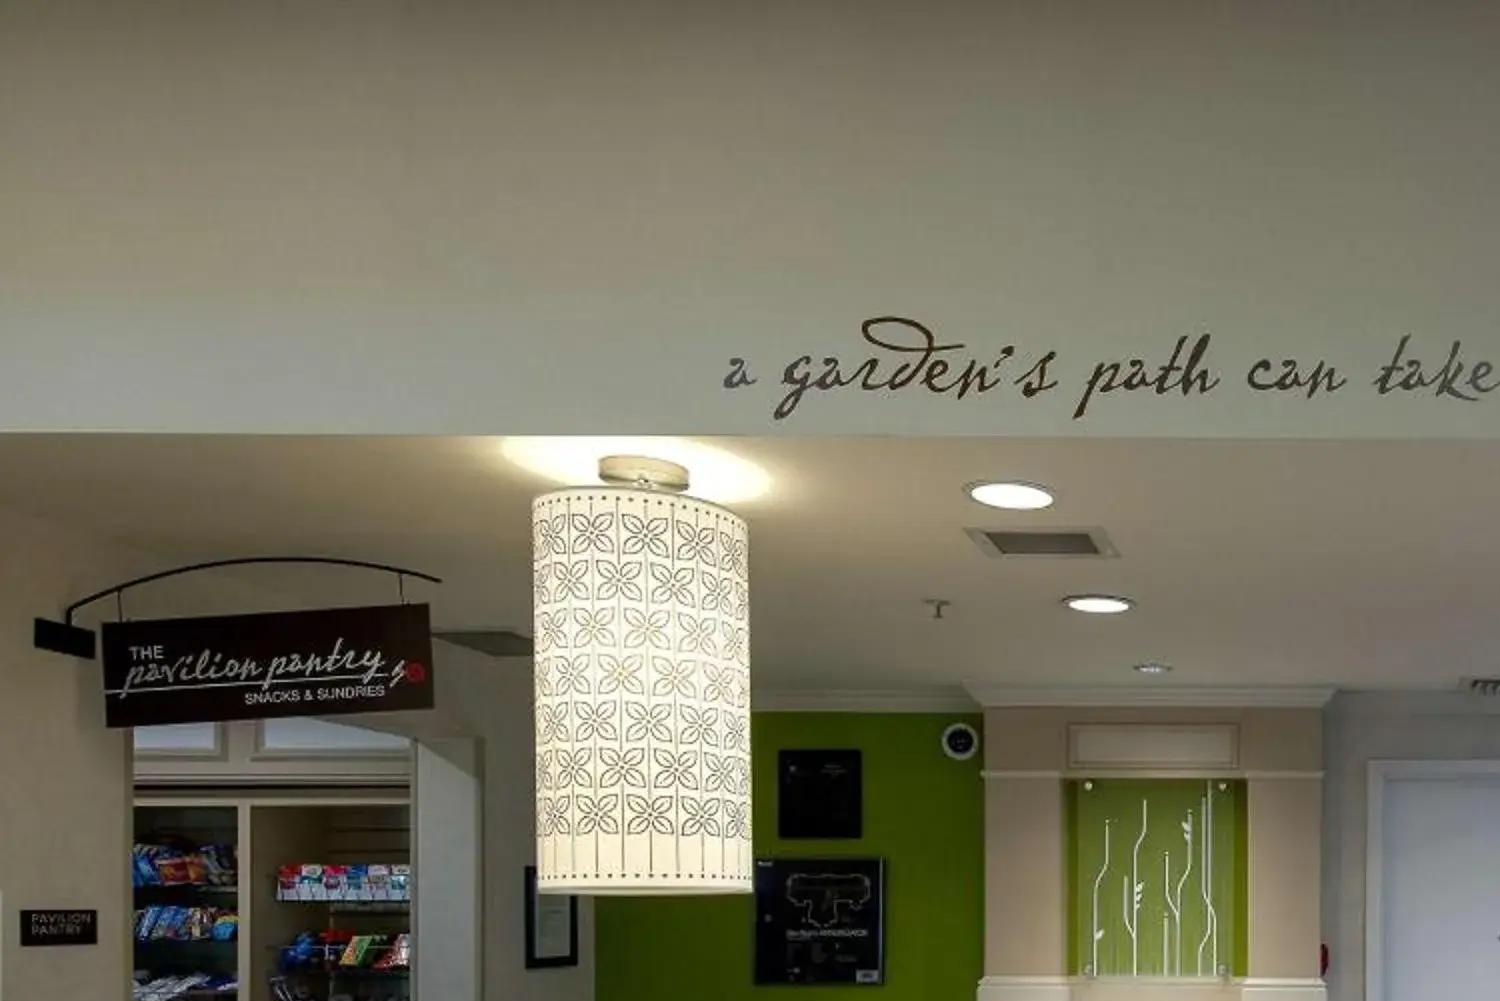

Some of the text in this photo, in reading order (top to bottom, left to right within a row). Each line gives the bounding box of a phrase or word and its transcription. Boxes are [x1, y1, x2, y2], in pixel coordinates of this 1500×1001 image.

[722, 357, 758, 389] a
[773, 316, 1059, 421] garden's
[1072, 333, 1221, 421] path
[1246, 358, 1348, 400] can
[128, 645, 165, 661] THE
[120, 637, 385, 700] pavilion pantry
[244, 684, 386, 705] SNACKS & SUNDRIES
[31, 913, 92, 924] PAVILION
[31, 924, 82, 935] PANTRY
